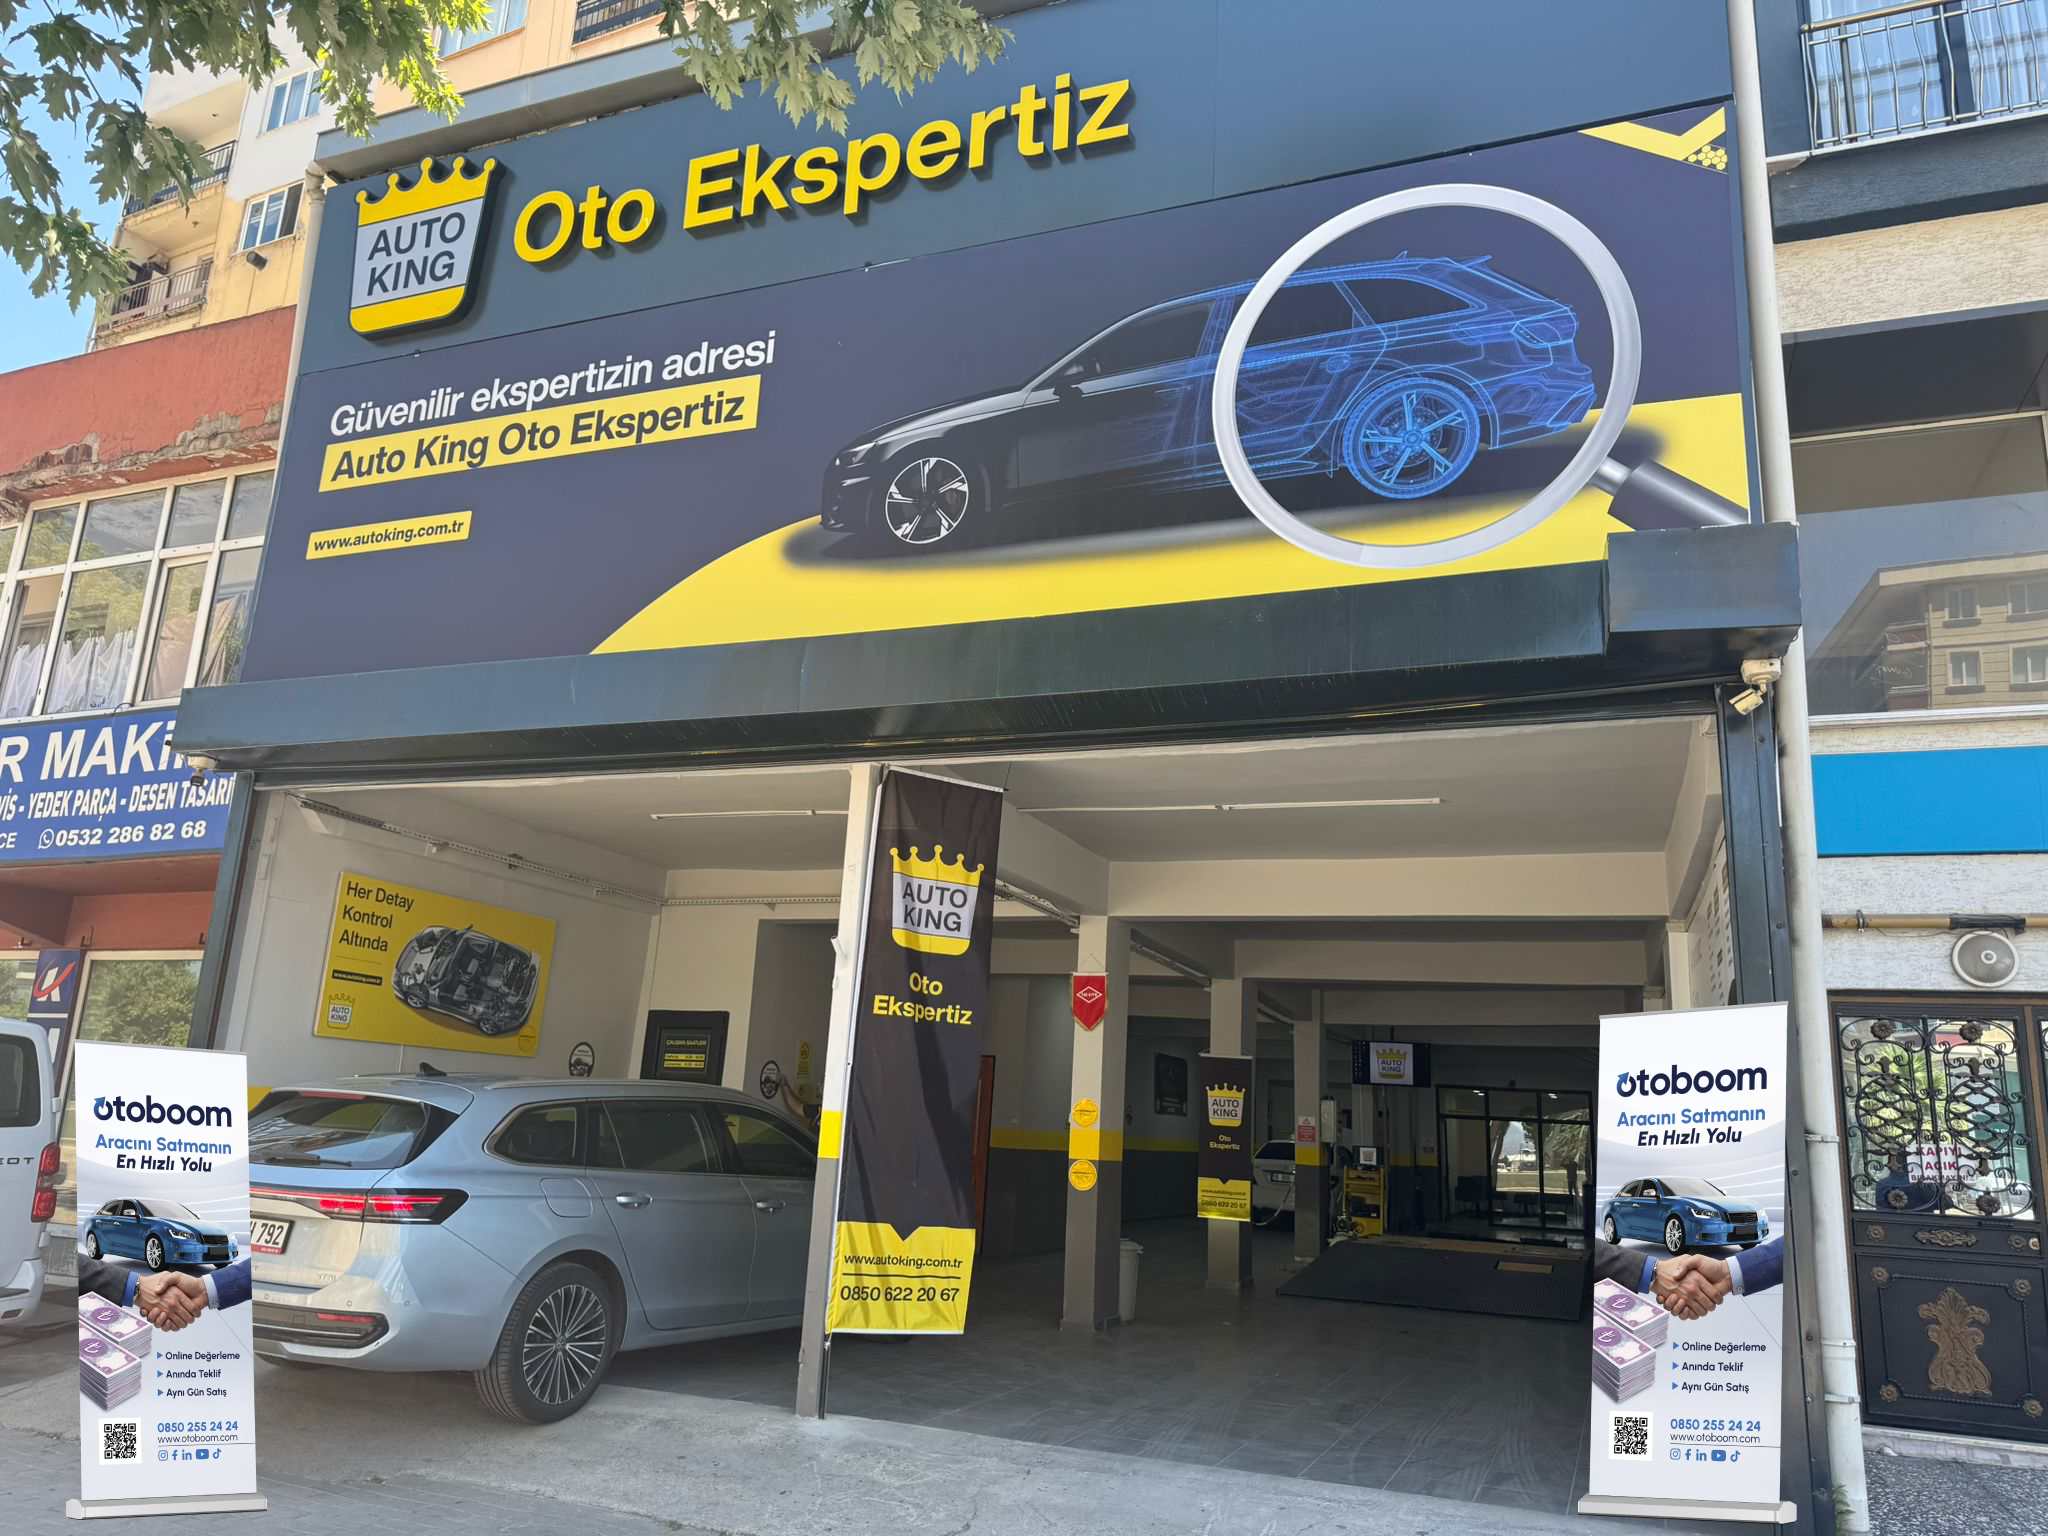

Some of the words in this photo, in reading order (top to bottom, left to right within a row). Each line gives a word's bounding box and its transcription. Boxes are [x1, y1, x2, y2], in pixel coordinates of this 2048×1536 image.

[512, 184, 656, 263] Oto
[682, 72, 1130, 230] Ekspertiz
[367, 211, 466, 262] AUTO
[366, 250, 456, 297] KING
[330, 388, 465, 437] Güvenilir
[470, 352, 653, 412] ekspertizin
[661, 330, 776, 380] adresi
[330, 449, 405, 481] Auto
[413, 433, 489, 469] King
[497, 420, 561, 455] Oto
[570, 390, 745, 445] Ekspertiz
[313, 519, 464, 552] www.autoking.com.tr
[27, 789, 75, 819] YEDEK
[72, 786, 118, 822] PARÇA
[128, 781, 178, 813] DESEN
[55, 828, 103, 847] 0532
[107, 825, 145, 844] 286
[150, 822, 175, 841] 82
[180, 819, 207, 839] 68
[346, 880, 373, 900] Her
[375, 887, 415, 913] Detay
[902, 881, 968, 909] AUTO
[342, 905, 394, 929] Kontrol
[903, 904, 962, 933] KING
[339, 929, 389, 952] Altında
[909, 971, 944, 996] Oto
[331, 1005, 350, 1014] AUTO
[331, 1013, 348, 1022] KING
[872, 994, 973, 1025] Ekspertiz
[1616, 1064, 1768, 1098] otoboom
[93, 1094, 232, 1127] otoboom
[1211, 1098, 1239, 1109] AUTO
[1212, 1108, 1238, 1118] KING
[1616, 1110, 1676, 1127] Aracını
[1681, 1107, 1766, 1125] Satmanın
[96, 1133, 152, 1151] Aracını
[157, 1136, 232, 1154] Satmanın
[1637, 1130, 1658, 1147] En
[1663, 1127, 1700, 1145] Hızlı
[1706, 1126, 1742, 1144] Yolu
[116, 1154, 136, 1169] En
[141, 1155, 175, 1171] Hızlı
[180, 1157, 212, 1172] Yolu
[256, 1222, 284, 1246] 792
[844, 1254, 963, 1270] www.autoking.com.tr
[840, 1285, 881, 1302] 0850
[884, 1286, 913, 1302] 622
[916, 1286, 936, 1302] 20
[940, 1287, 960, 1303] 67
[165, 1351, 193, 1360] Online
[195, 1351, 240, 1362] Değerleme
[1681, 1341, 1712, 1352] Online
[1714, 1341, 1767, 1354] Değerleme
[166, 1369, 197, 1379] Anında
[198, 1369, 222, 1378] Teklif
[1681, 1361, 1716, 1372] Anında
[1717, 1361, 1744, 1372] Teklif
[166, 1388, 185, 1398] Aynı
[187, 1387, 205, 1397] Gün
[206, 1387, 227, 1398] Satış
[1681, 1382, 1702, 1394] Aynı
[1704, 1382, 1724, 1392] Gün
[1726, 1382, 1750, 1394] Satış
[158, 1422, 185, 1433] 0850
[187, 1421, 207, 1432] 255
[210, 1421, 222, 1431] 24
[225, 1420, 238, 1431] 24
[1670, 1418, 1700, 1430] 0850
[1702, 1419, 1725, 1431] 255
[1728, 1420, 1743, 1431] 24
[1746, 1420, 1760, 1432] 24
[158, 1433, 238, 1443] www.otoboom.com
[1670, 1433, 1760, 1443] www.otoboom.com
